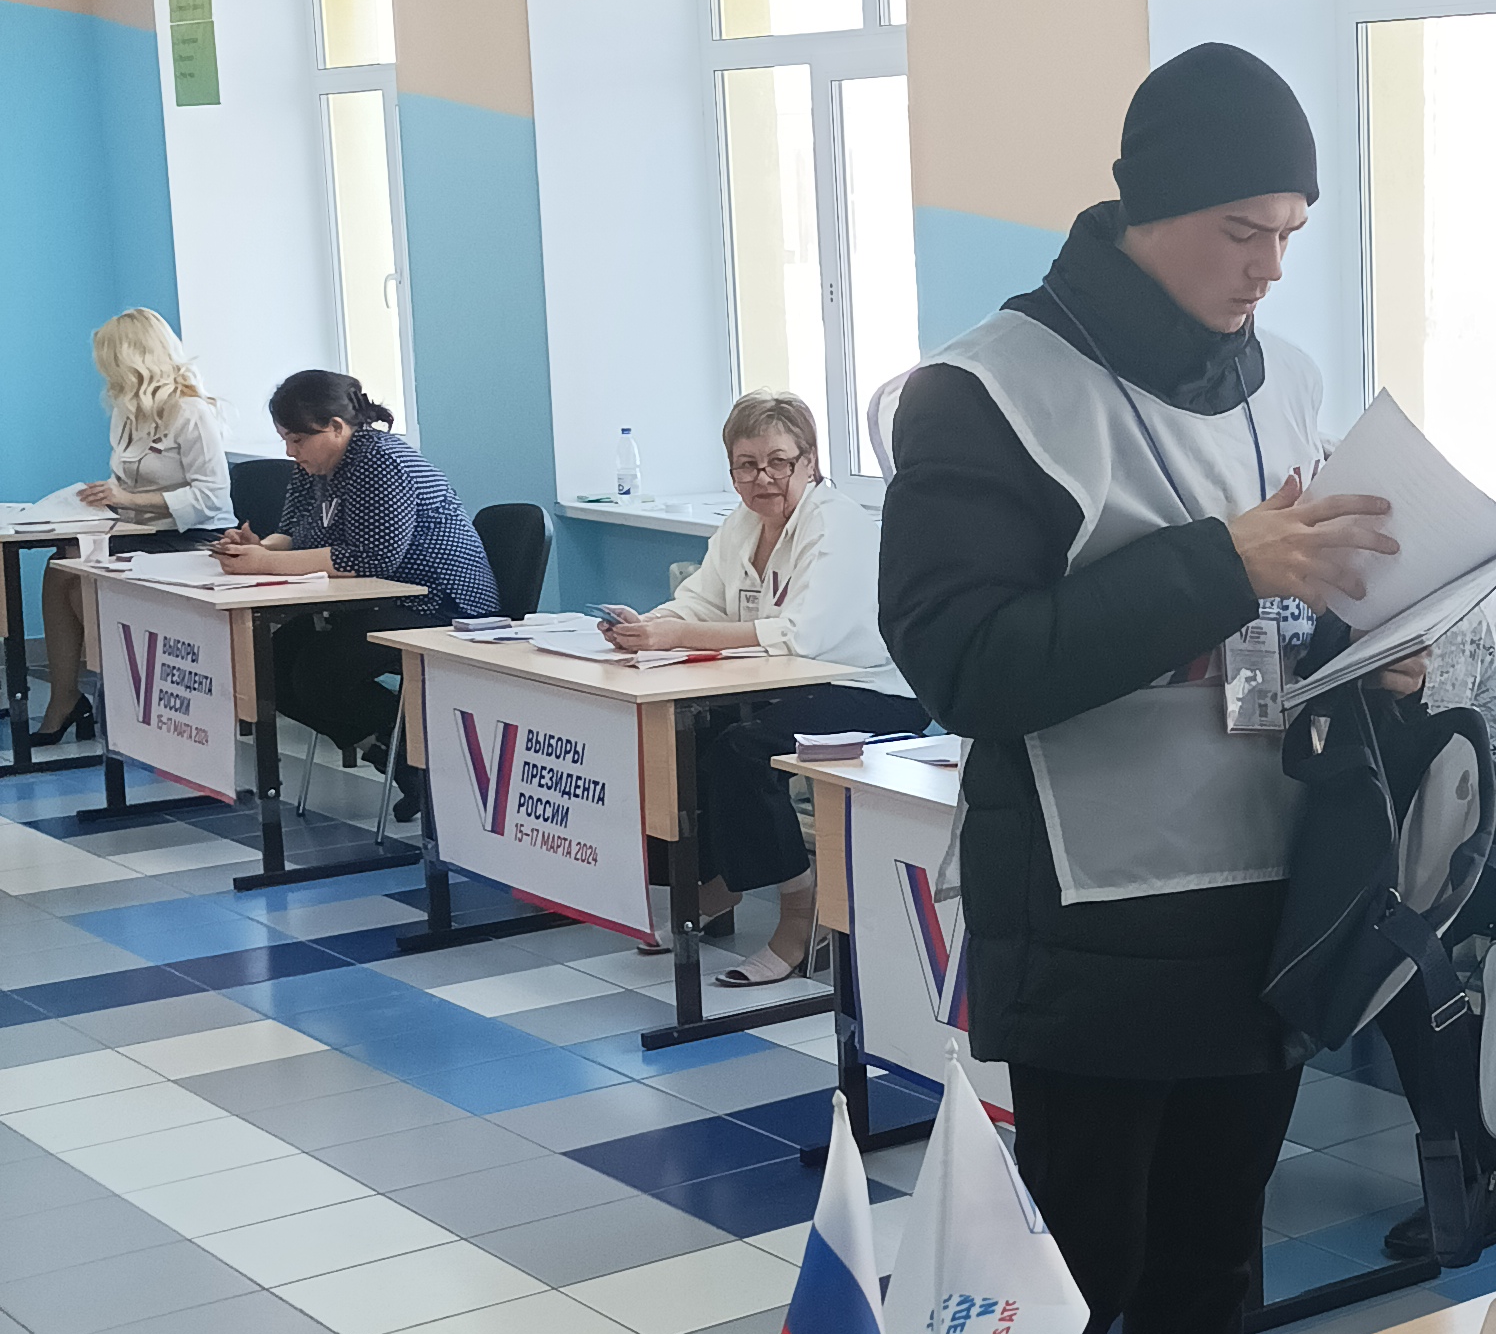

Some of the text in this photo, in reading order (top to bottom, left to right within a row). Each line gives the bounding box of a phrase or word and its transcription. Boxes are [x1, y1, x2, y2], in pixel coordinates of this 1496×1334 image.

[162, 635, 200, 664] ВЫБОРЫ
[159, 662, 213, 697] ПРЕЗИДЕНТА
[157, 688, 191, 716] РОССИИ
[173, 723, 193, 742] МАРТА
[525, 729, 586, 766] ВЫБОРЫ
[521, 761, 606, 806] ПРЕЗИДЕНТА
[517, 792, 570, 829] РОССИИ
[540, 835, 572, 859] МАРТА
[574, 841, 598, 867] 2024
